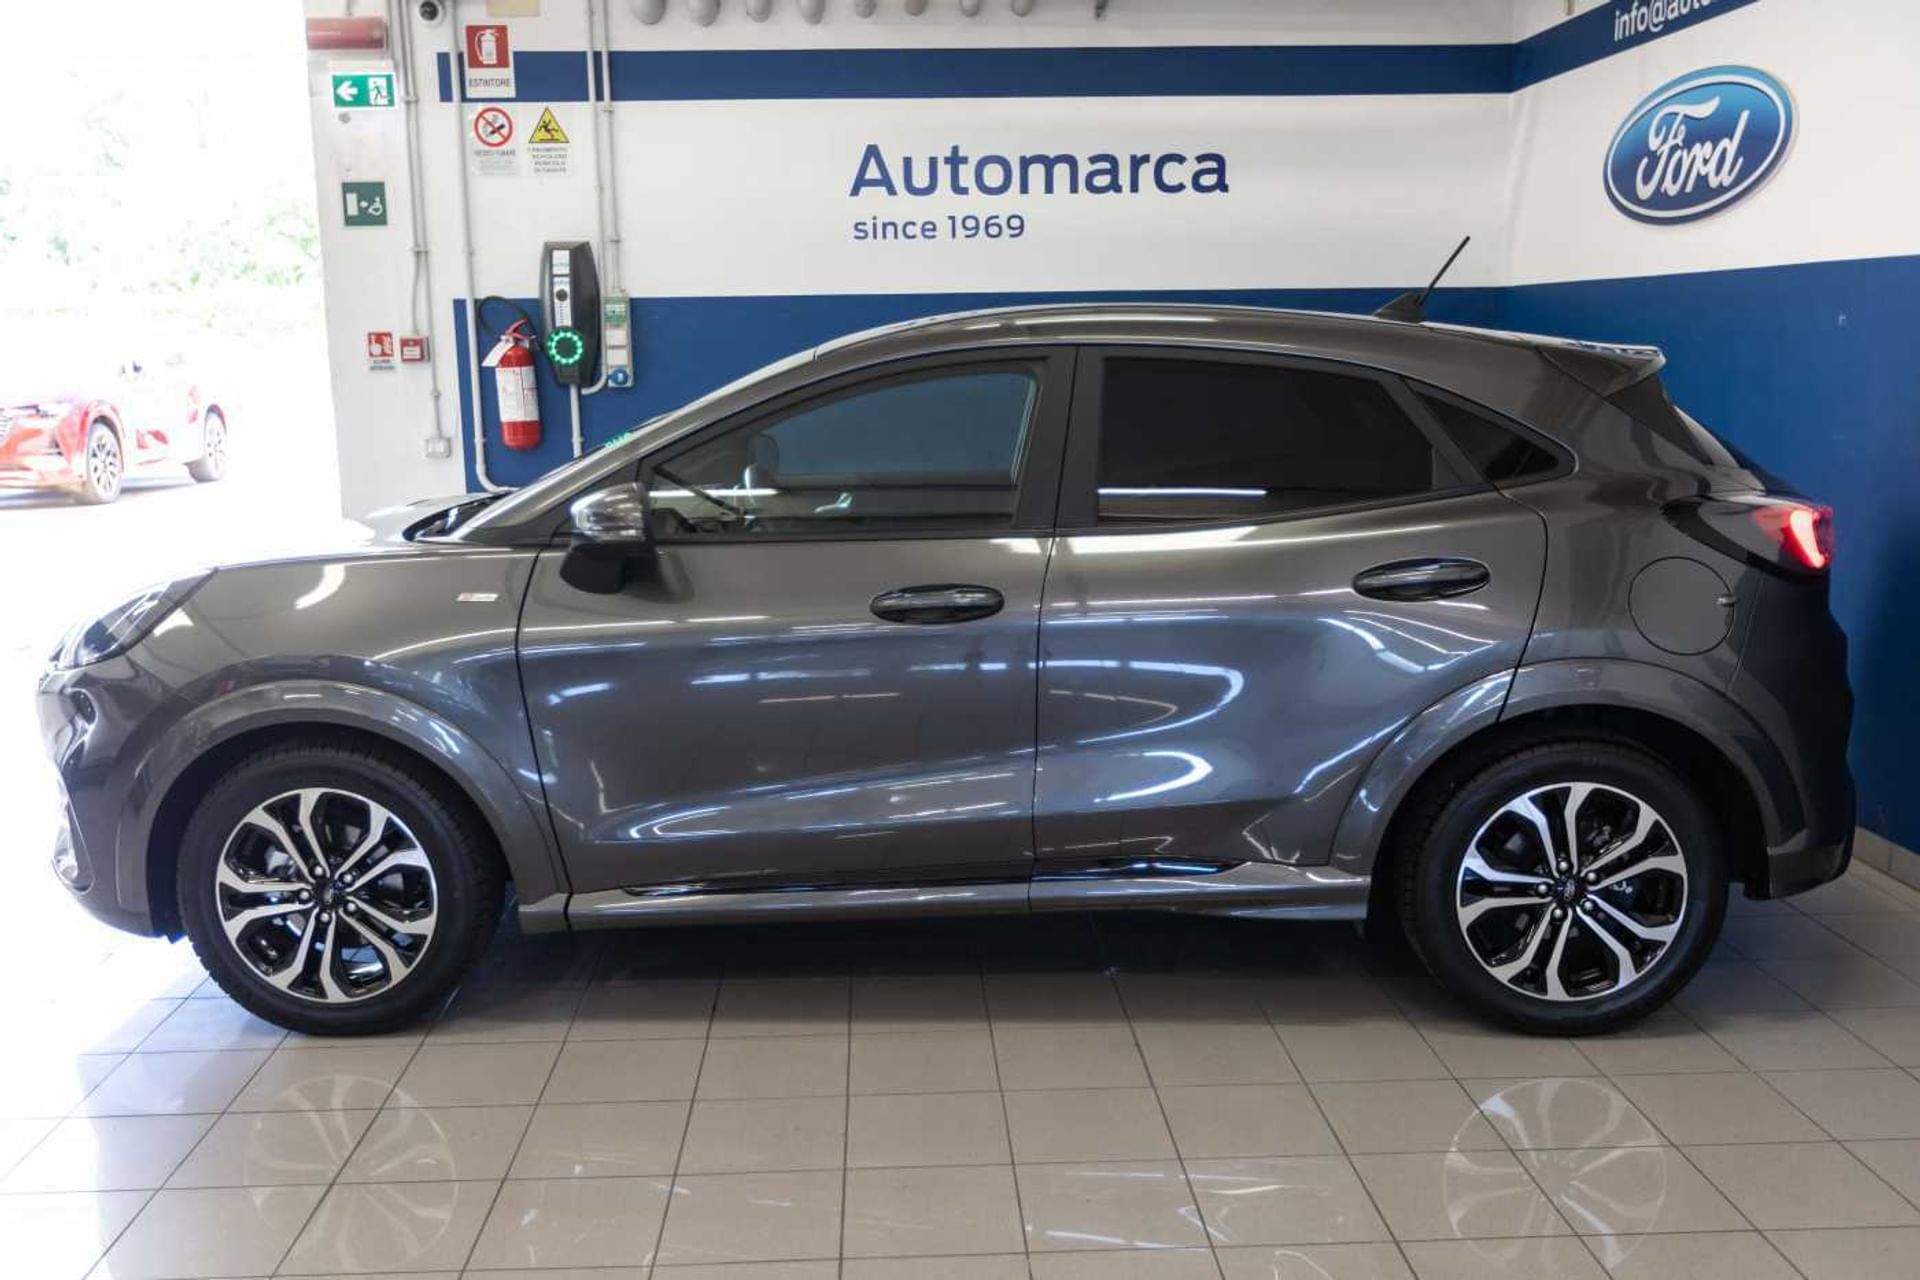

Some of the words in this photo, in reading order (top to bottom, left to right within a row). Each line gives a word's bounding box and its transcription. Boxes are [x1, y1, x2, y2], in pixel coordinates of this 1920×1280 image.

[1614, 0, 1711, 42] info@au
[849, 143, 1230, 197] Automarca
[1635, 96, 1750, 201] Ford
[853, 215, 938, 240] since
[946, 213, 1026, 240] 1969
